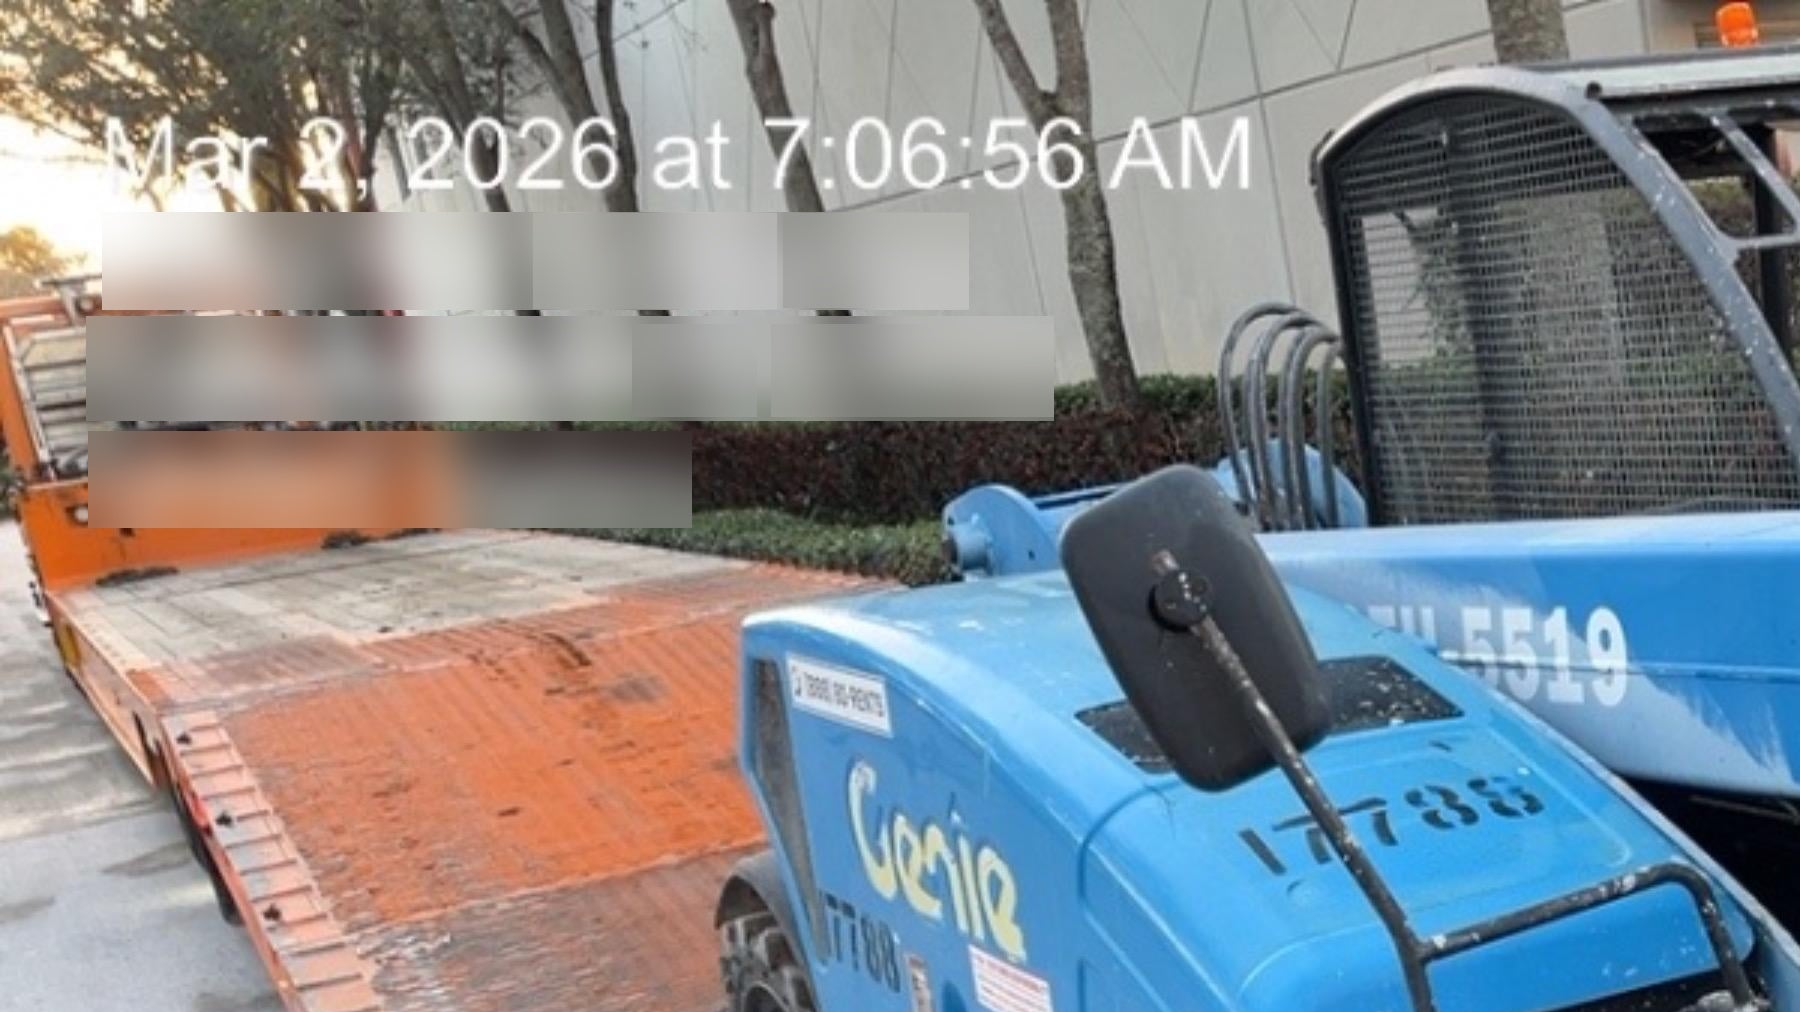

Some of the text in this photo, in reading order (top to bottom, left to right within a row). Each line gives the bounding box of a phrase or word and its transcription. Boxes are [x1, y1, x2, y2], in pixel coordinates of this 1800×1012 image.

[1366, 604, 1628, 706] -5519
[848, 757, 1028, 963] Genie
[1238, 777, 1545, 876] 17788
